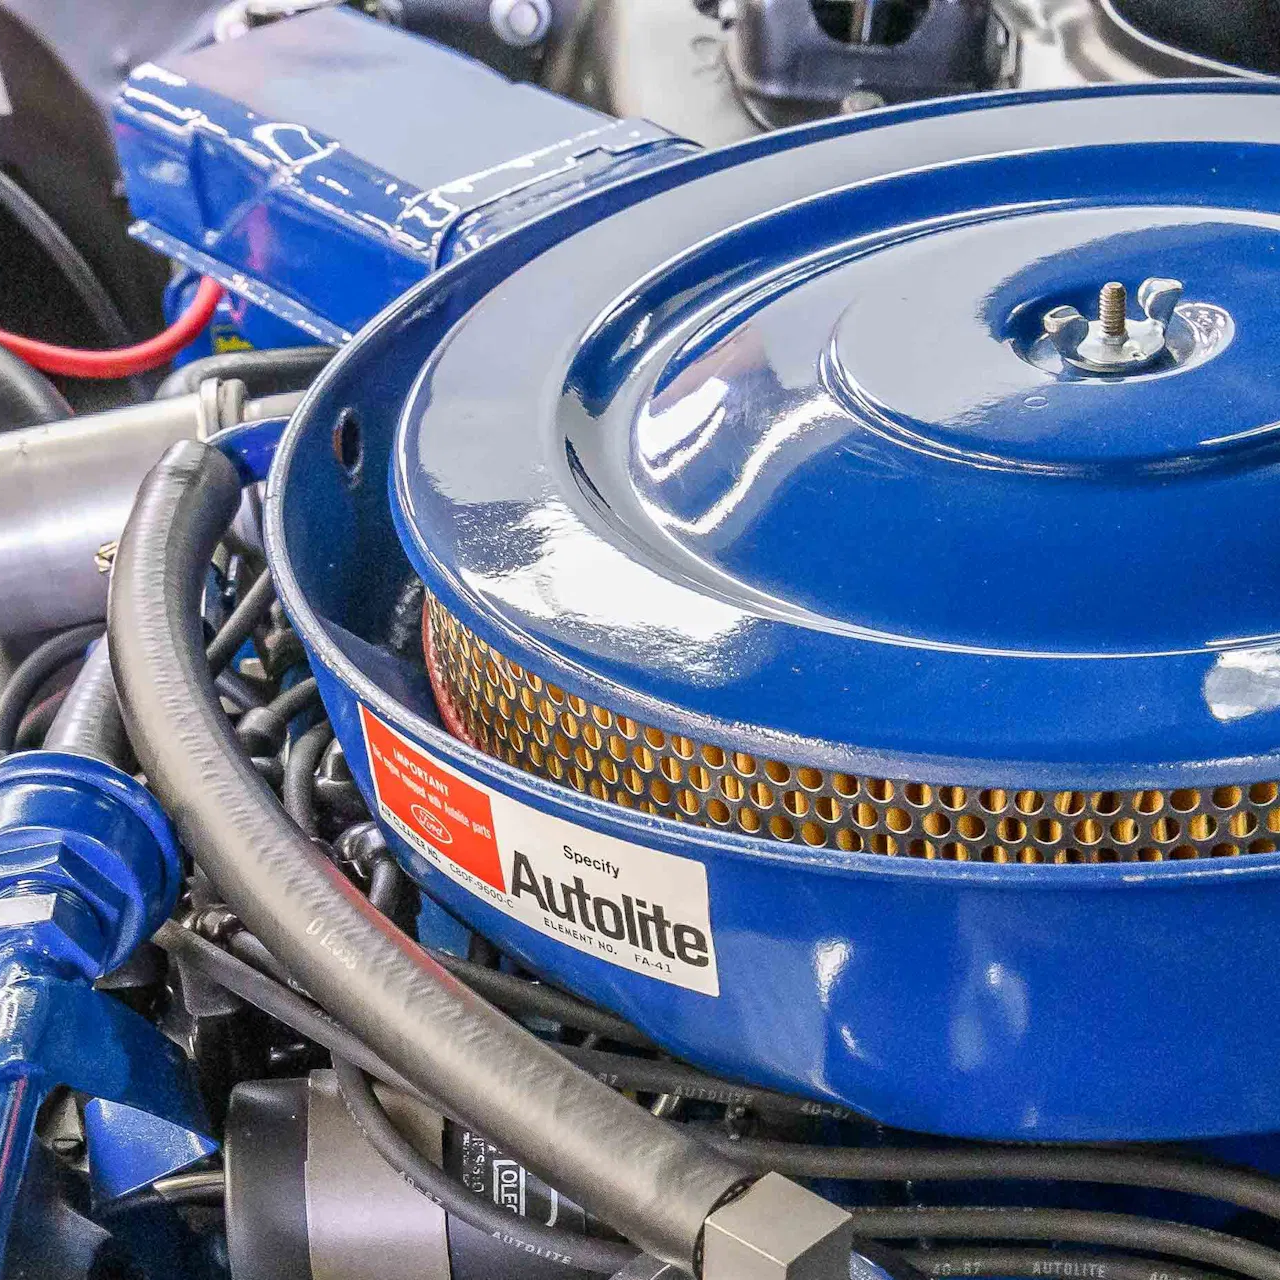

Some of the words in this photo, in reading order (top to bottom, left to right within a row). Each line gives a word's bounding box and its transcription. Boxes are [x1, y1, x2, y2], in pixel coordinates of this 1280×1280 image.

[392, 747, 449, 797] IMPORTANT
[393, 816, 427, 848] CLEANER
[472, 820, 491, 840] parts
[563, 844, 620, 880] Specify
[511, 849, 710, 968] Autolite
[543, 917, 594, 946] ELEMENT
[597, 941, 618, 956] NO.
[634, 953, 673, 974] FA-41
[492, 1230, 573, 1266] AUTOLITE
[1032, 1260, 1107, 1280] AUTOLITE
